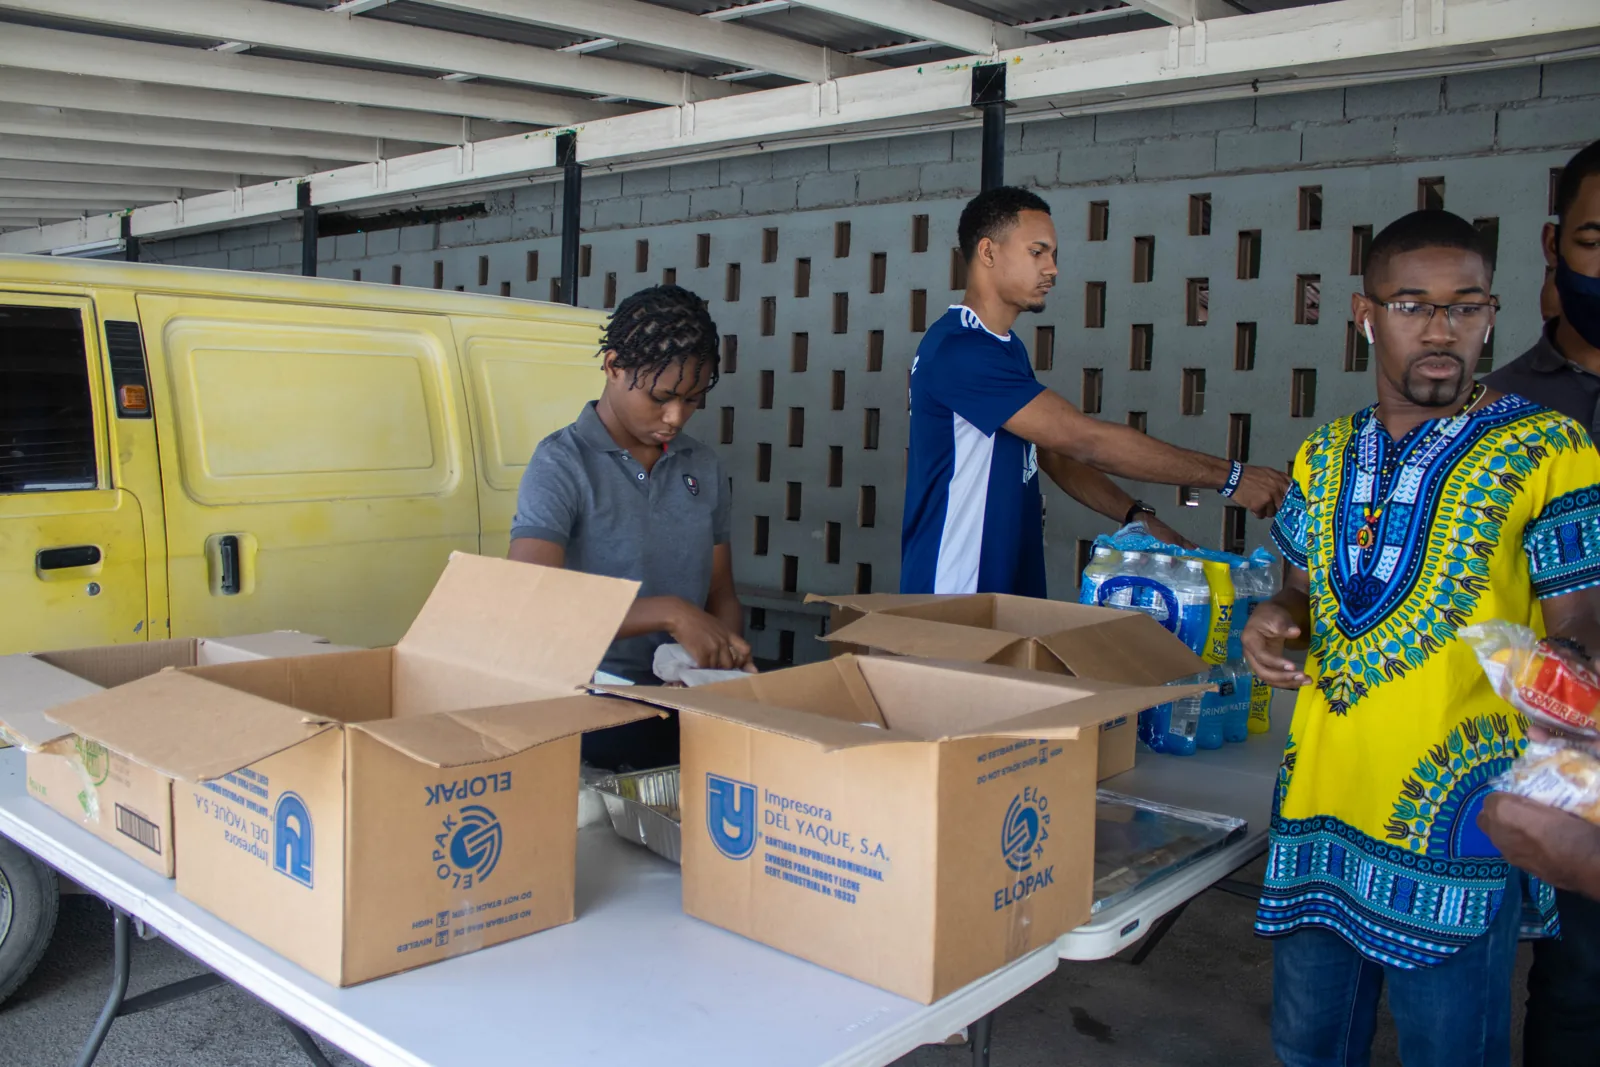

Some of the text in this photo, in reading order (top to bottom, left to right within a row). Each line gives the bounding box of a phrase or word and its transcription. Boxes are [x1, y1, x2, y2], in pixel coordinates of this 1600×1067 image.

[424, 771, 512, 806] ELOPAK
[764, 788, 832, 822] Impresora
[212, 800, 247, 834] YAQUE,
[251, 822, 269, 845] DEL
[1024, 786, 1050, 860] ELOPAK
[224, 829, 269, 867] Impresora
[432, 814, 473, 890] ELOPAK
[764, 809, 890, 862] DEL YAQUE, S.A.
[799, 846, 836, 867] REPUBLICA
[782, 871, 821, 893] INDUSTRIAL
[794, 862, 811, 876] PARA
[839, 877, 860, 893] LECHE
[994, 865, 1054, 912] ELOPAK
